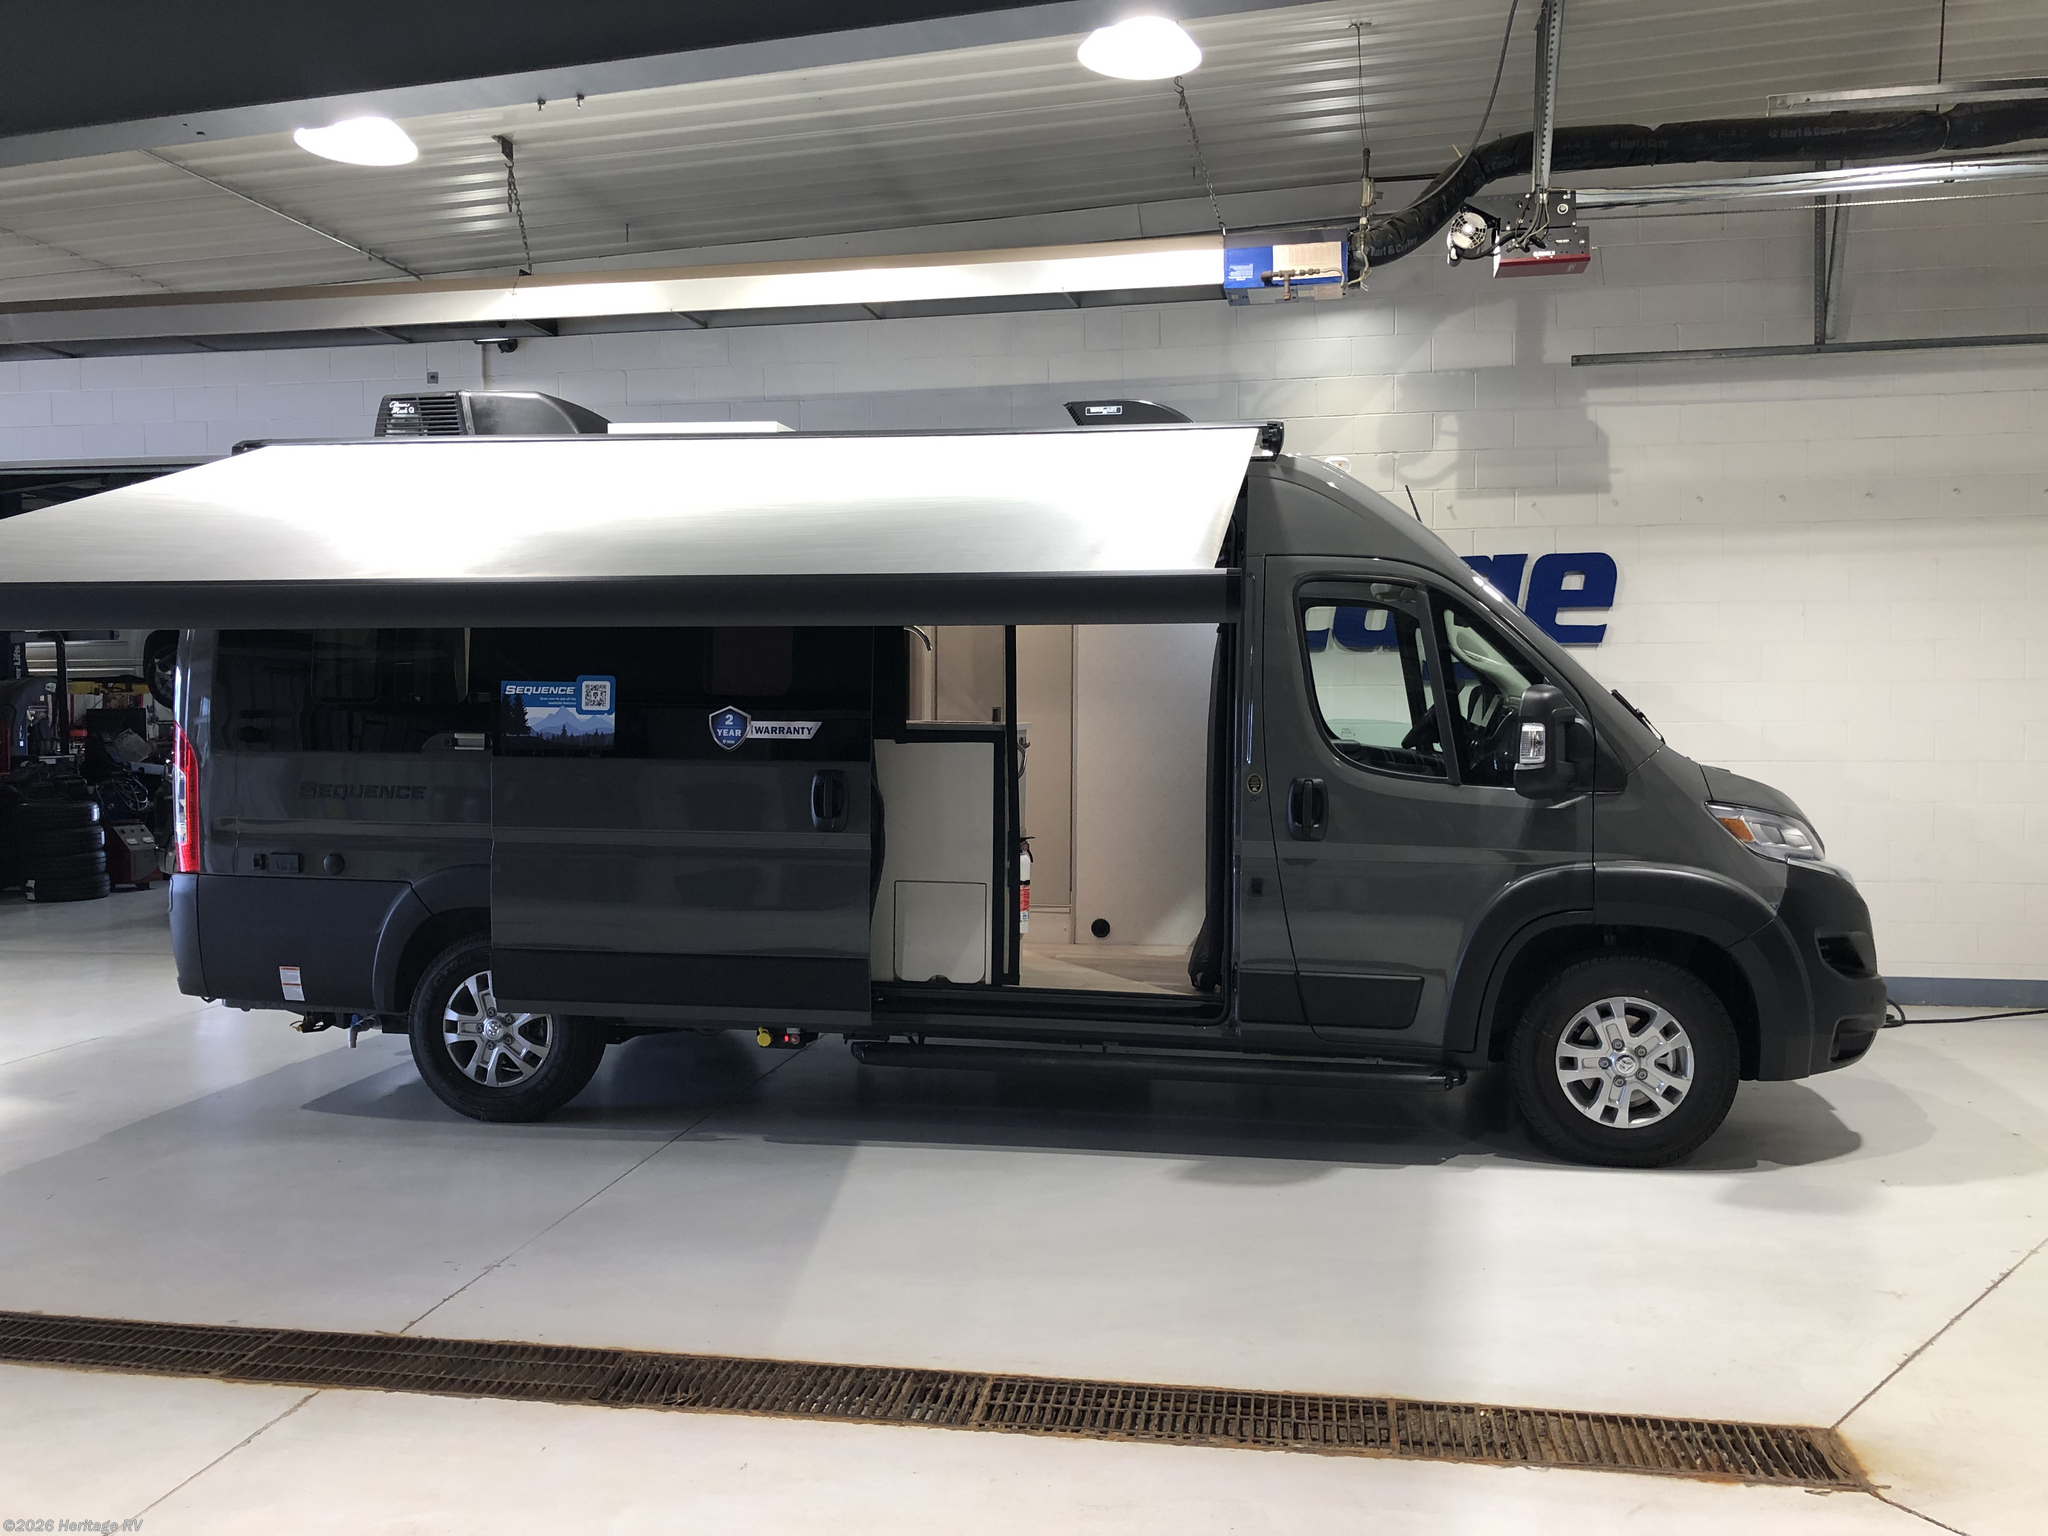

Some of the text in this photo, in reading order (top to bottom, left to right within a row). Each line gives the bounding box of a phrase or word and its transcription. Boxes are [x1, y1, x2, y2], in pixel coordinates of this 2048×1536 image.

[408, 406, 415, 414] Q
[505, 685, 576, 696] SEQUENCE
[725, 714, 734, 725] 2
[716, 729, 742, 737] YEAR
[754, 726, 814, 735] WARRANTY
[300, 781, 428, 799] SEQUENCE
